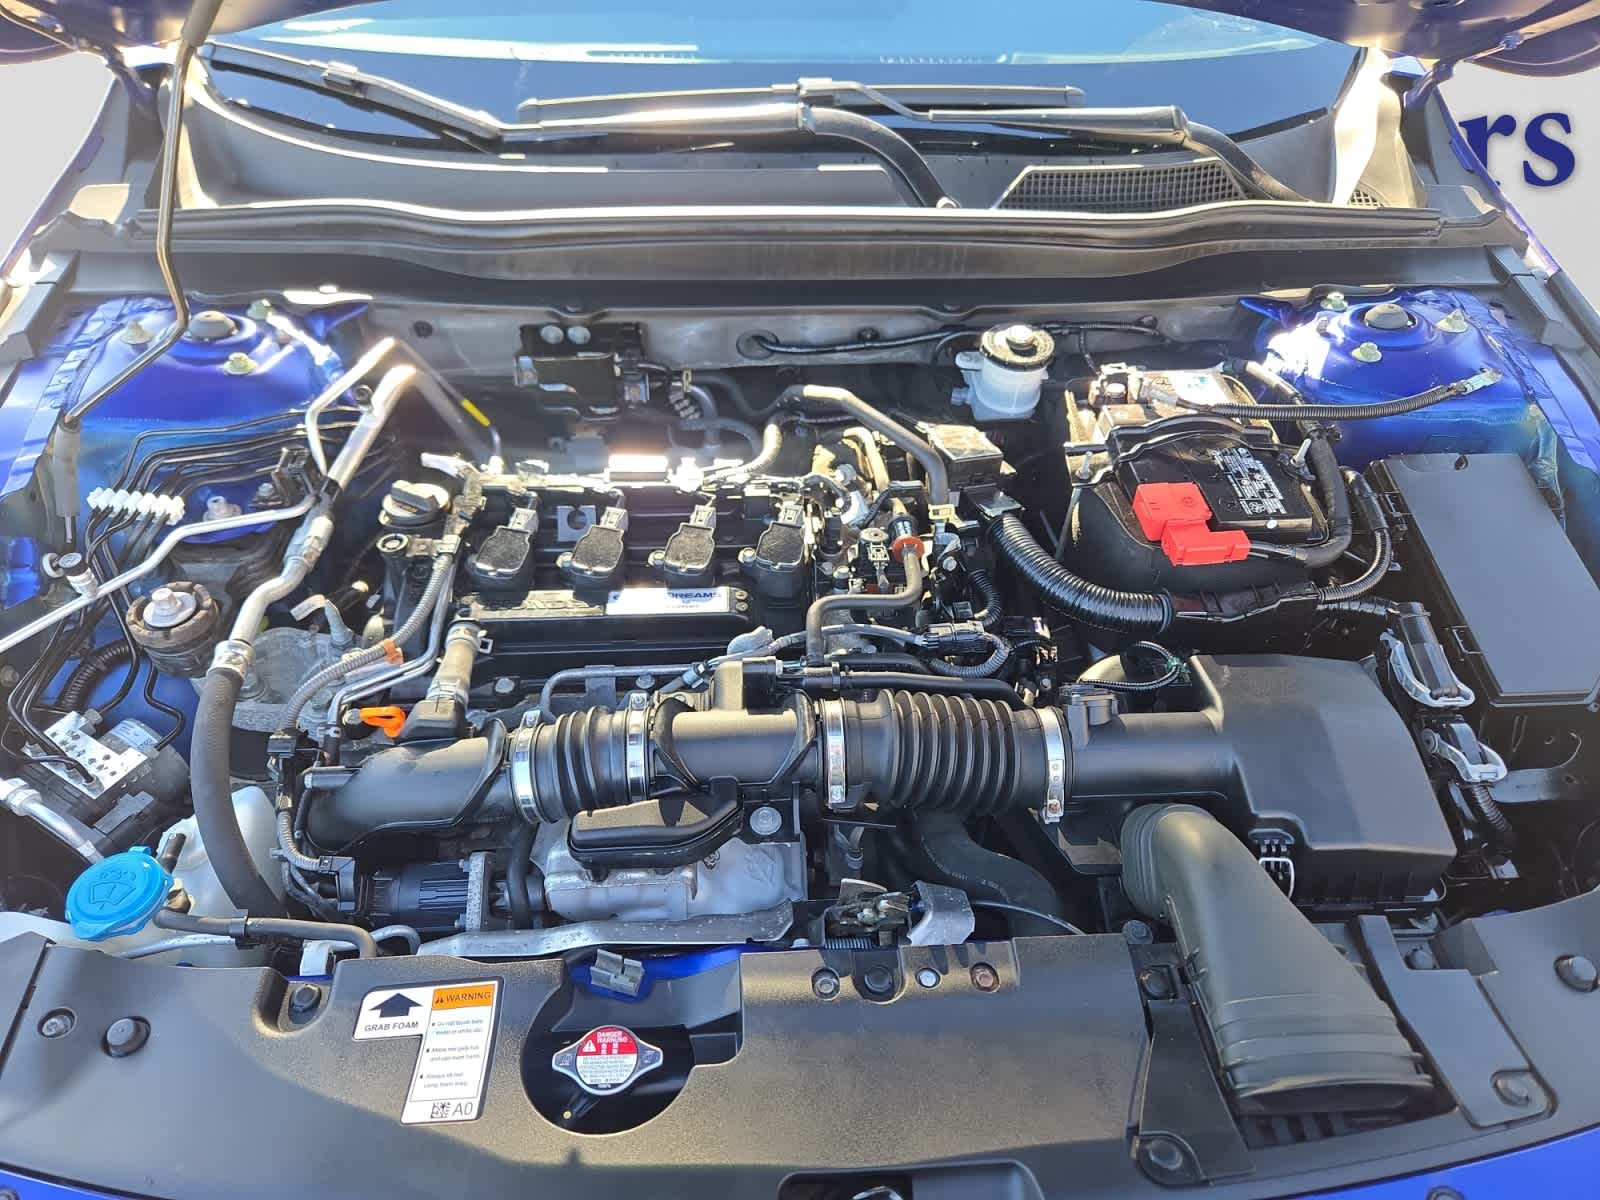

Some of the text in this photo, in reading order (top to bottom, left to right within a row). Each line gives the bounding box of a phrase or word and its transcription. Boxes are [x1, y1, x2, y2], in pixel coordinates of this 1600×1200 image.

[446, 991, 491, 1003] WARNING
[364, 1020, 419, 1032] GRAB FOAM
[452, 1101, 474, 1117] A0
